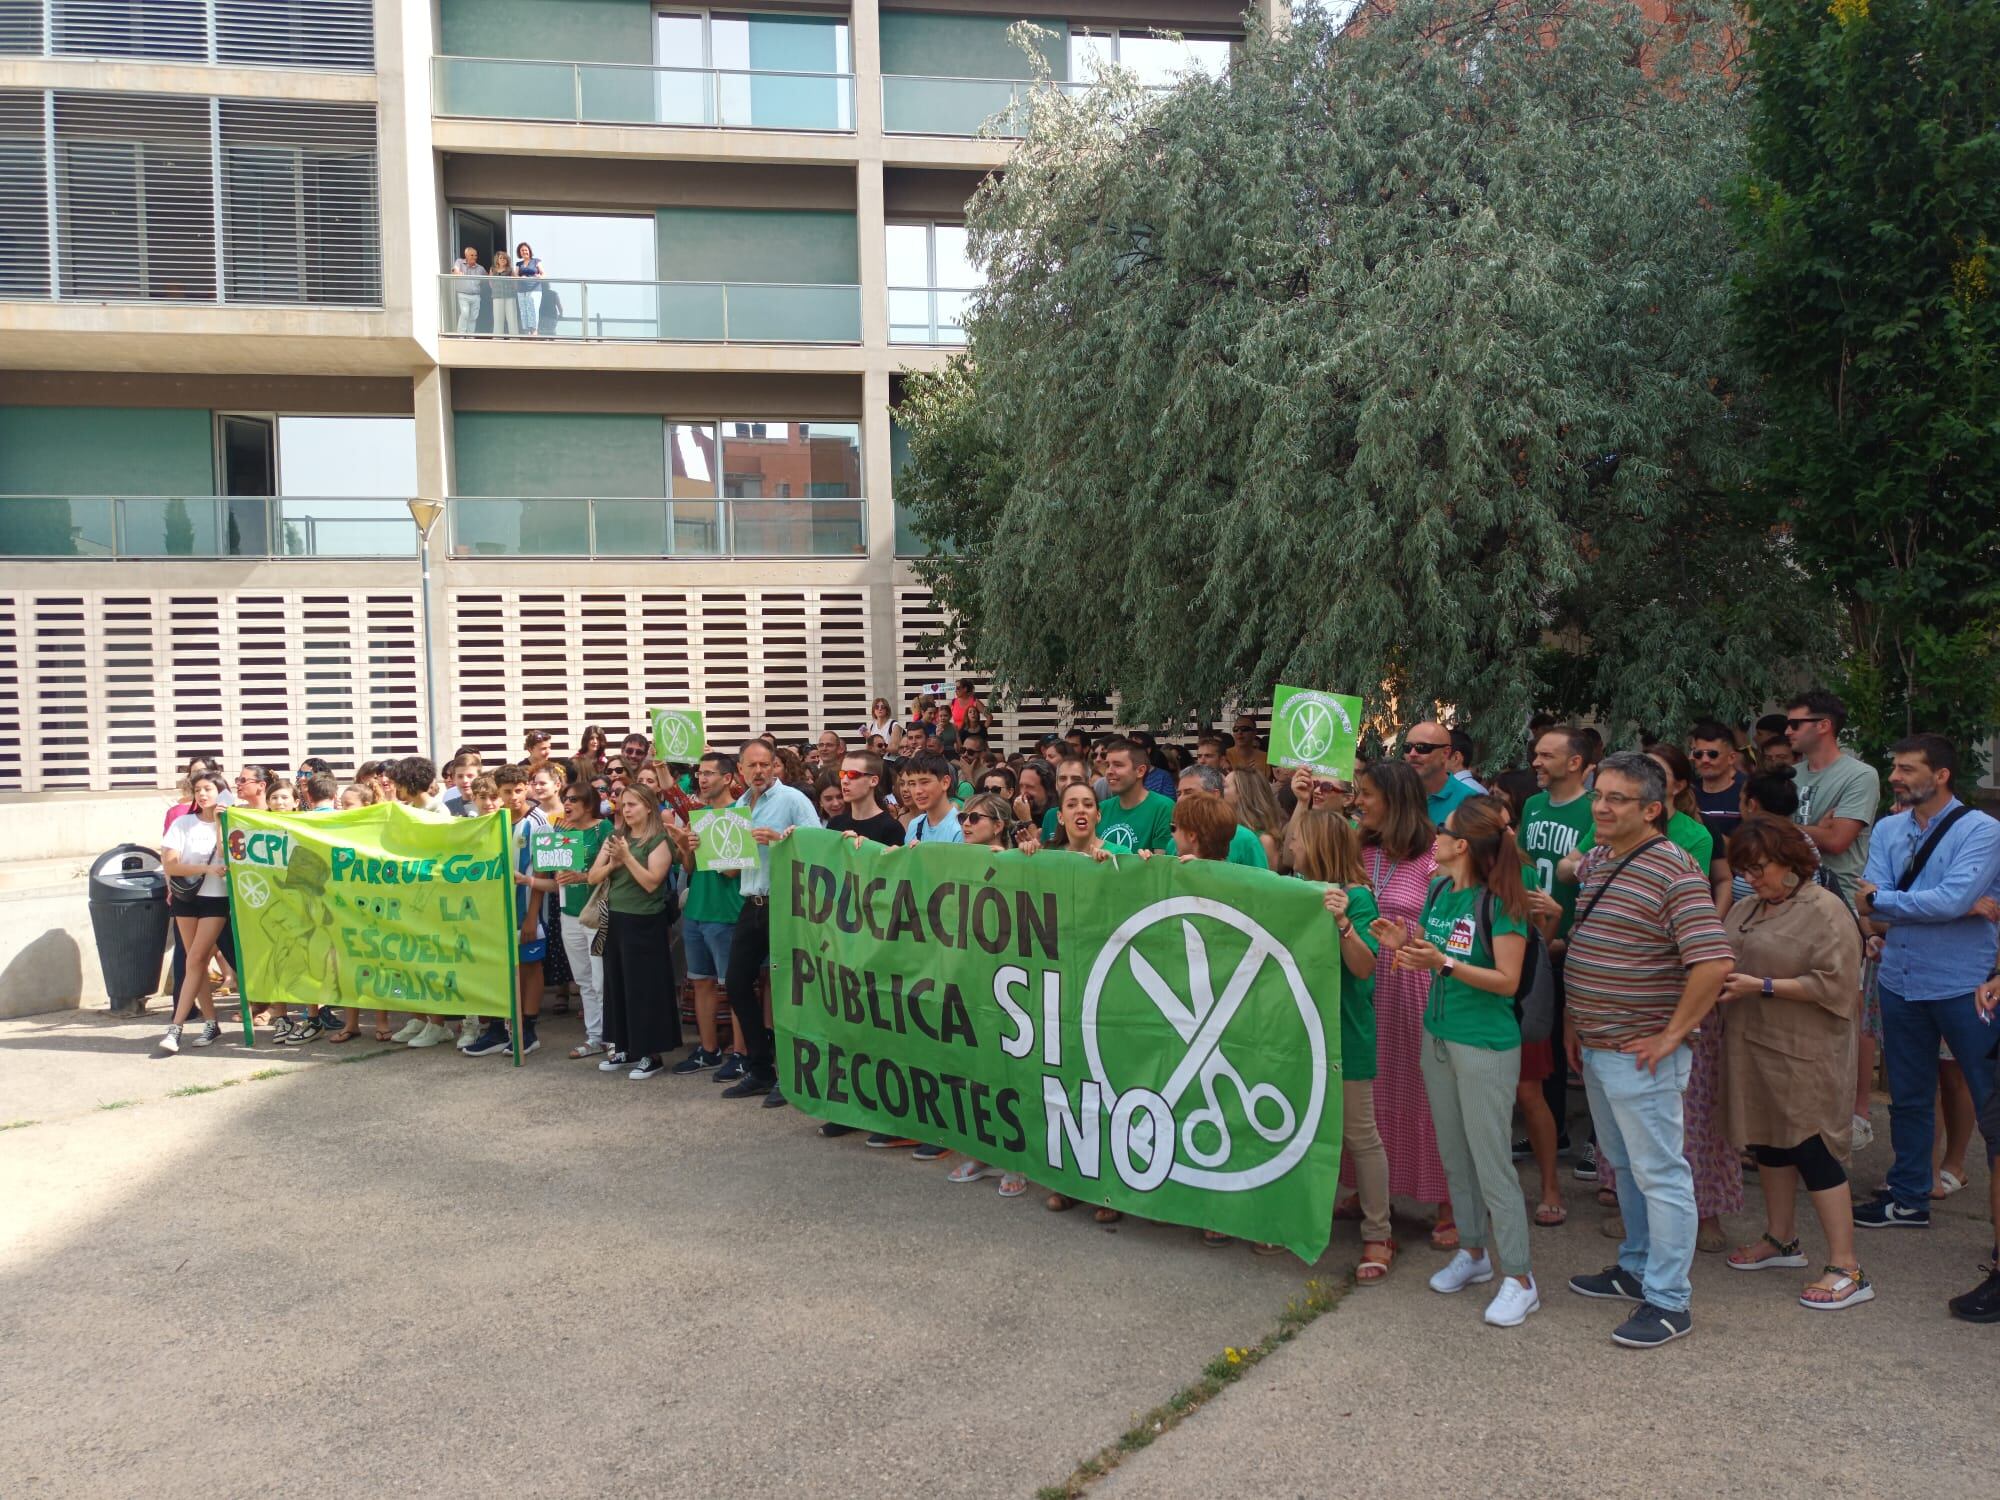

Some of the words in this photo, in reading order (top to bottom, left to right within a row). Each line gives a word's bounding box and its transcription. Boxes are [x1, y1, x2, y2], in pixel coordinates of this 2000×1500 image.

[1526, 820, 1579, 857] BOSTON
[331, 847, 437, 885] PARQUE
[354, 896, 402, 921] POR
[439, 895, 481, 922] LA
[791, 859, 1060, 961] EDUCACIÓN
[341, 927, 476, 963] ESCUELA
[791, 940, 979, 1048] PÚBLICA
[991, 963, 1063, 1068] SI
[792, 1036, 1027, 1153] RECORTES
[1041, 1073, 1176, 1191] NO
